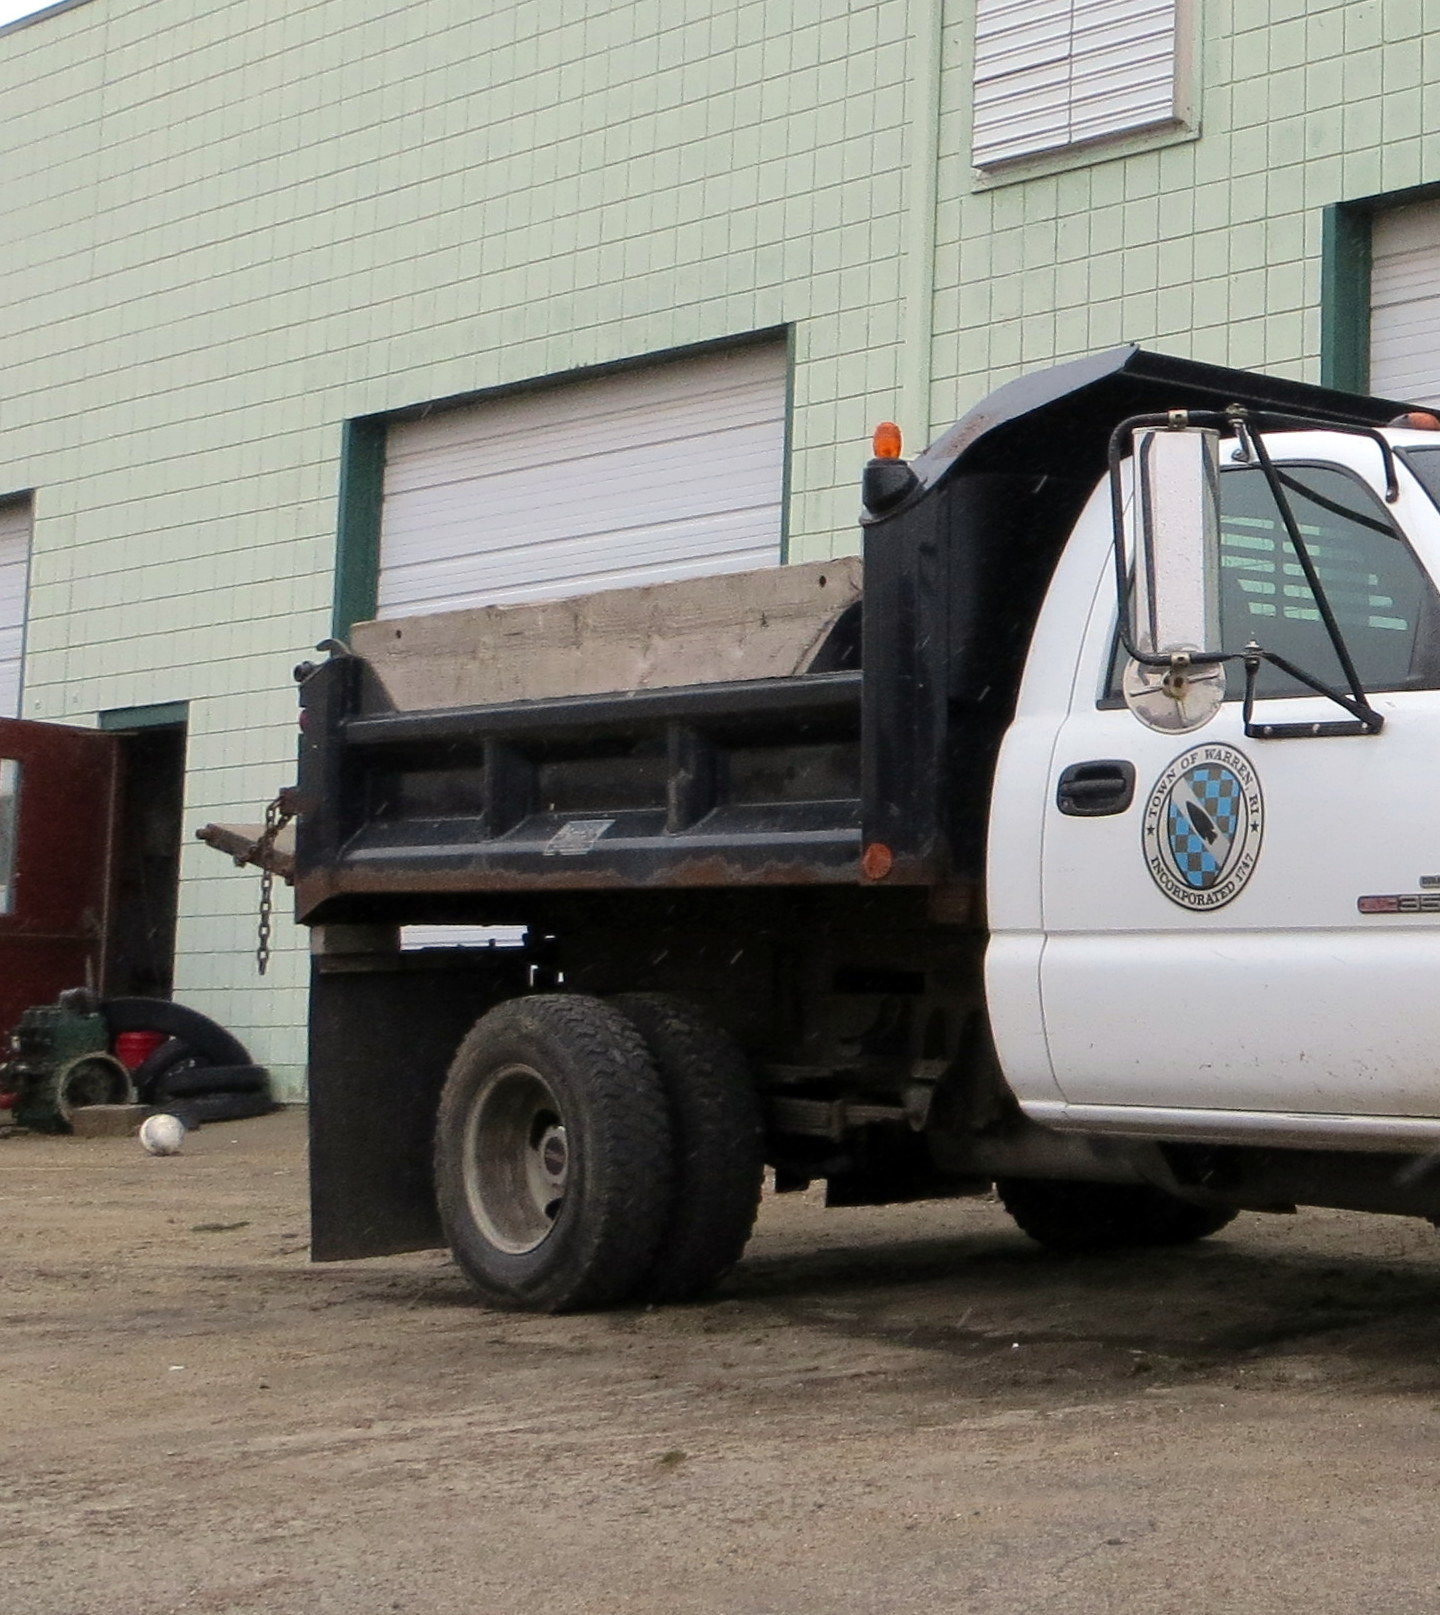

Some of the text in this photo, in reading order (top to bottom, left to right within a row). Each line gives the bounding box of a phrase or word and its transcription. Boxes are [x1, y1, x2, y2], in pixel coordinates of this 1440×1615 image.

[1149, 748, 1260, 818] TOWN OF WARREN, RI
[1151, 853, 1254, 906] INCORPORATED 1747
